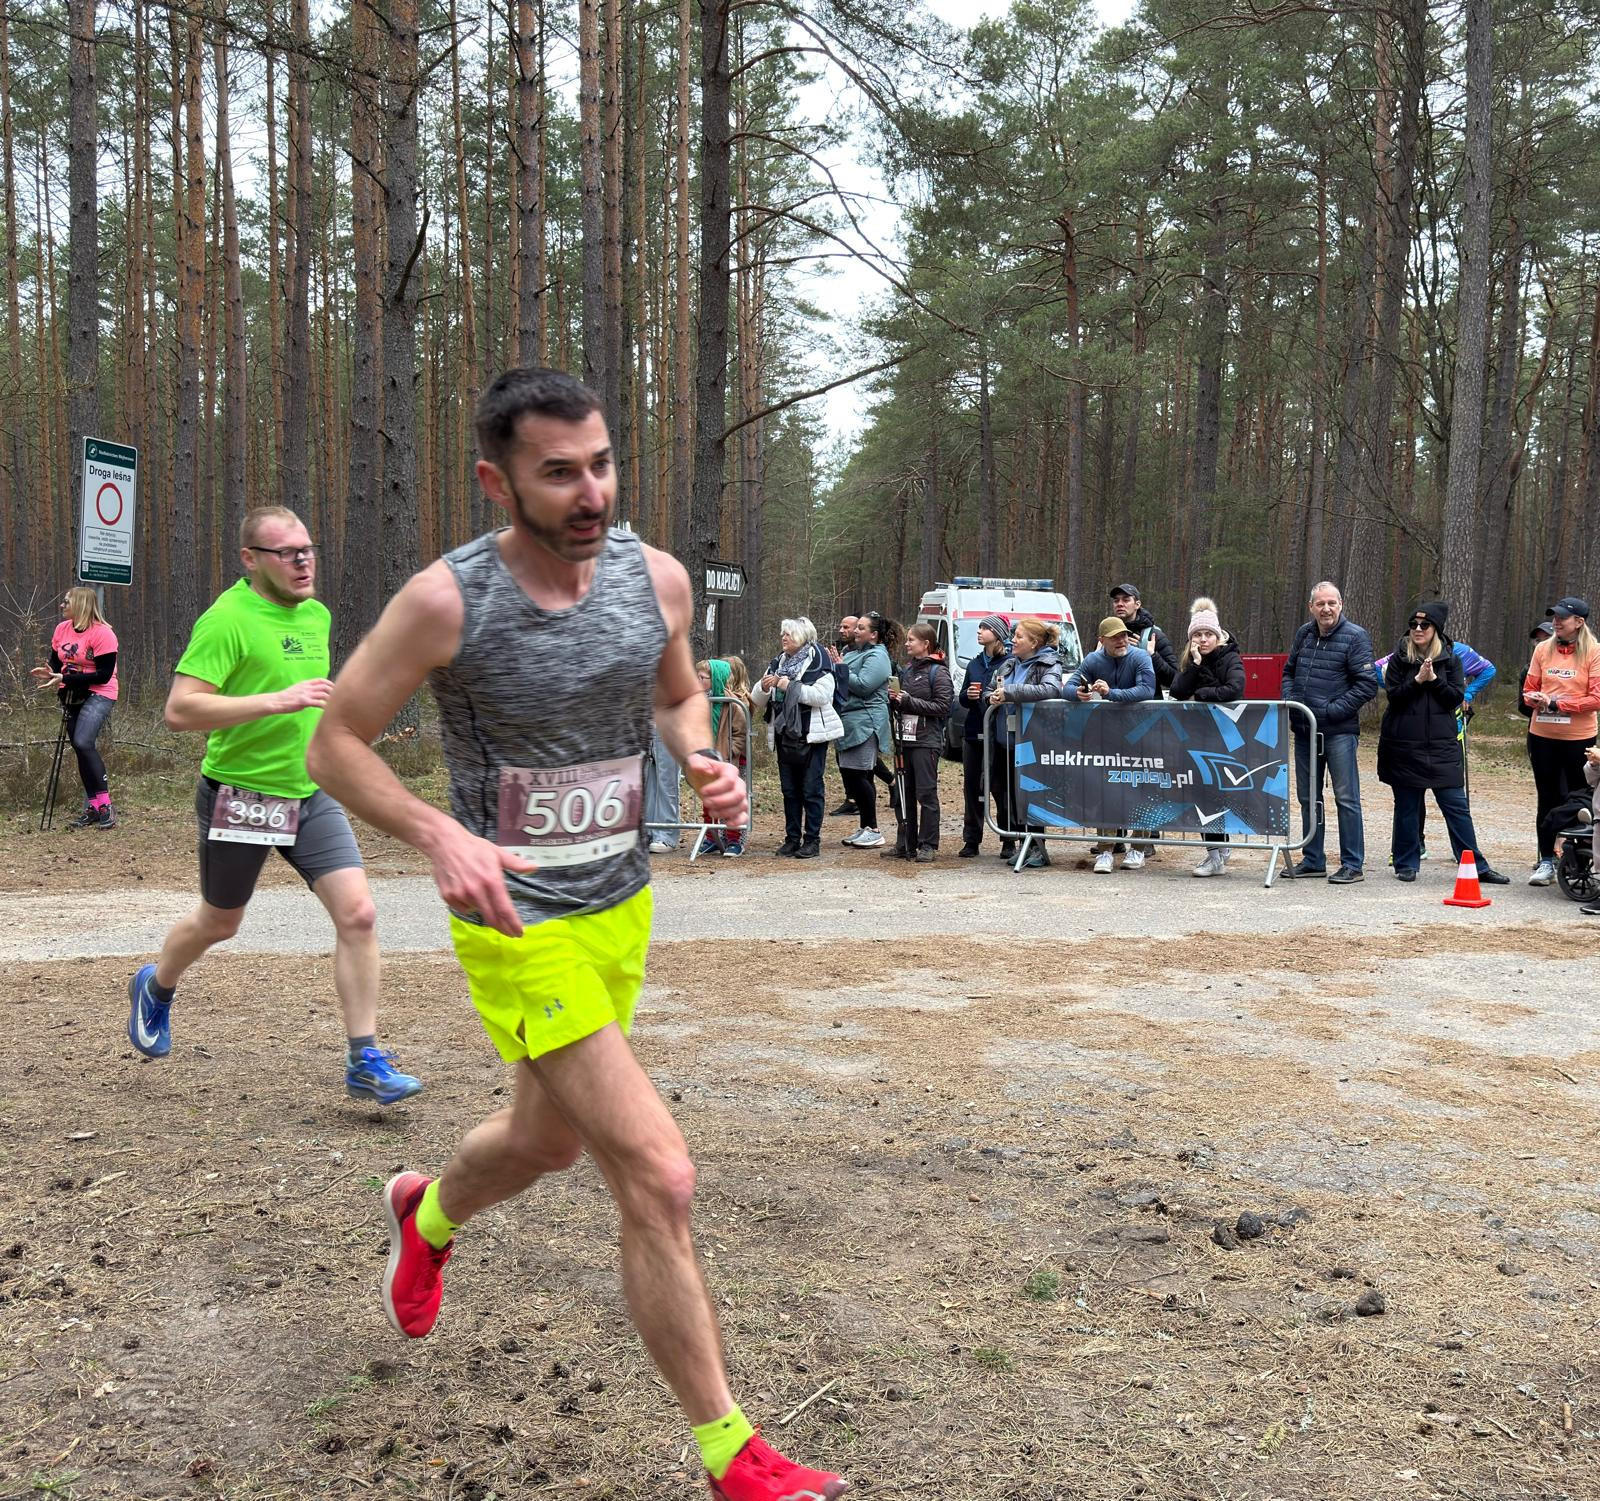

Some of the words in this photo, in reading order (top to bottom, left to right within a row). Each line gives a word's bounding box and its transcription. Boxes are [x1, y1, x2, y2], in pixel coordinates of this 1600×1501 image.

[89, 465, 111, 480] Droga
[112, 469, 132, 482] leśna
[706, 569, 716, 589] DO
[716, 570, 741, 592] KAPLICY
[1040, 750, 1164, 769] elektroniczne
[528, 769, 578, 786] XVIII
[1107, 768, 1194, 789] zapisy.pl
[226, 800, 286, 828] 386
[521, 779, 625, 837] 506
